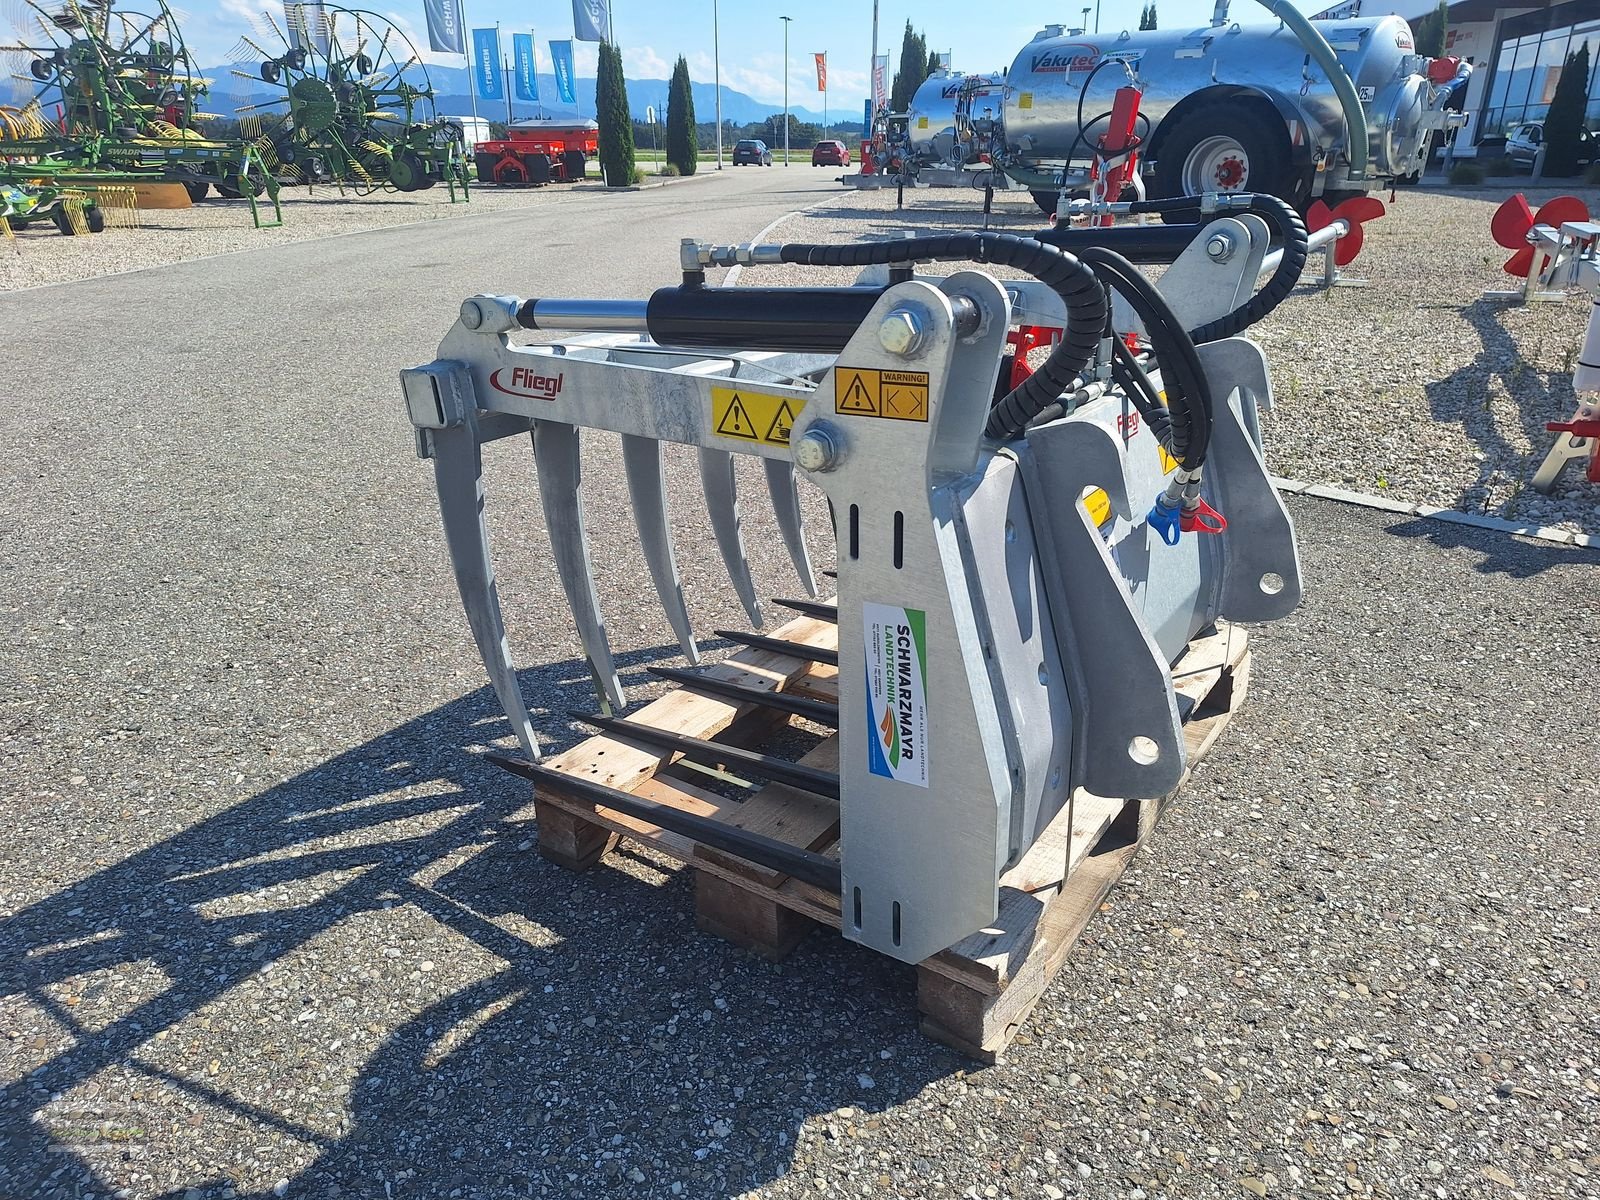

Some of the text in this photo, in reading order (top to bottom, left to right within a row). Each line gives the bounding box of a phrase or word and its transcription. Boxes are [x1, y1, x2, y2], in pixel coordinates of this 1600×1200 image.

[1031, 51, 1099, 73] Vakutec
[1359, 88, 1368, 100] 25
[512, 367, 563, 397] Fliegl
[884, 373, 925, 382] WARNING!
[885, 625, 895, 704] LANDTECHNIK
[897, 624, 913, 760] SCHWARZMAYR
